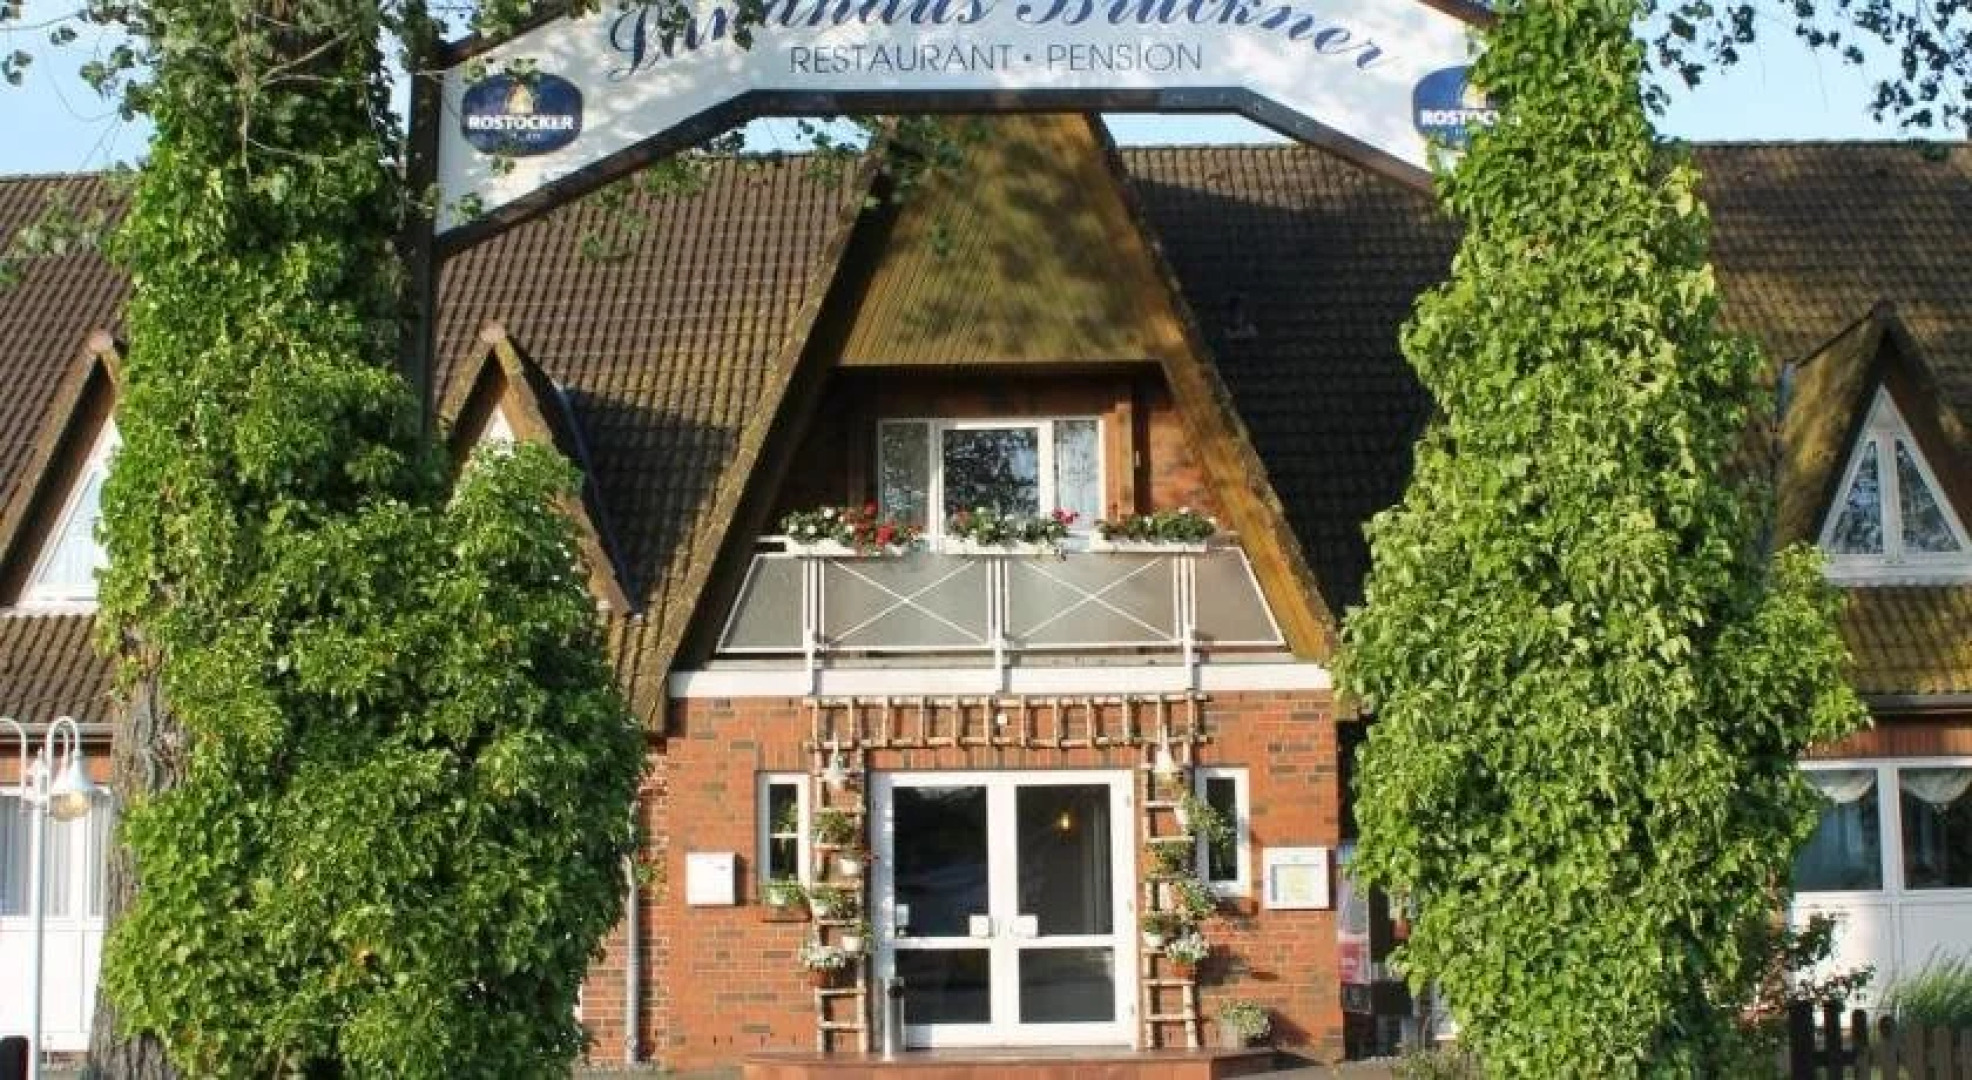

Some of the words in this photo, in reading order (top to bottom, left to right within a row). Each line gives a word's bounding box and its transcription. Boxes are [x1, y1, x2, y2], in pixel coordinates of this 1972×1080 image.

[790, 44, 1013, 74] RESTAURANT
[1047, 43, 1202, 71] PENSION
[467, 114, 574, 131] ROSTOCKER
